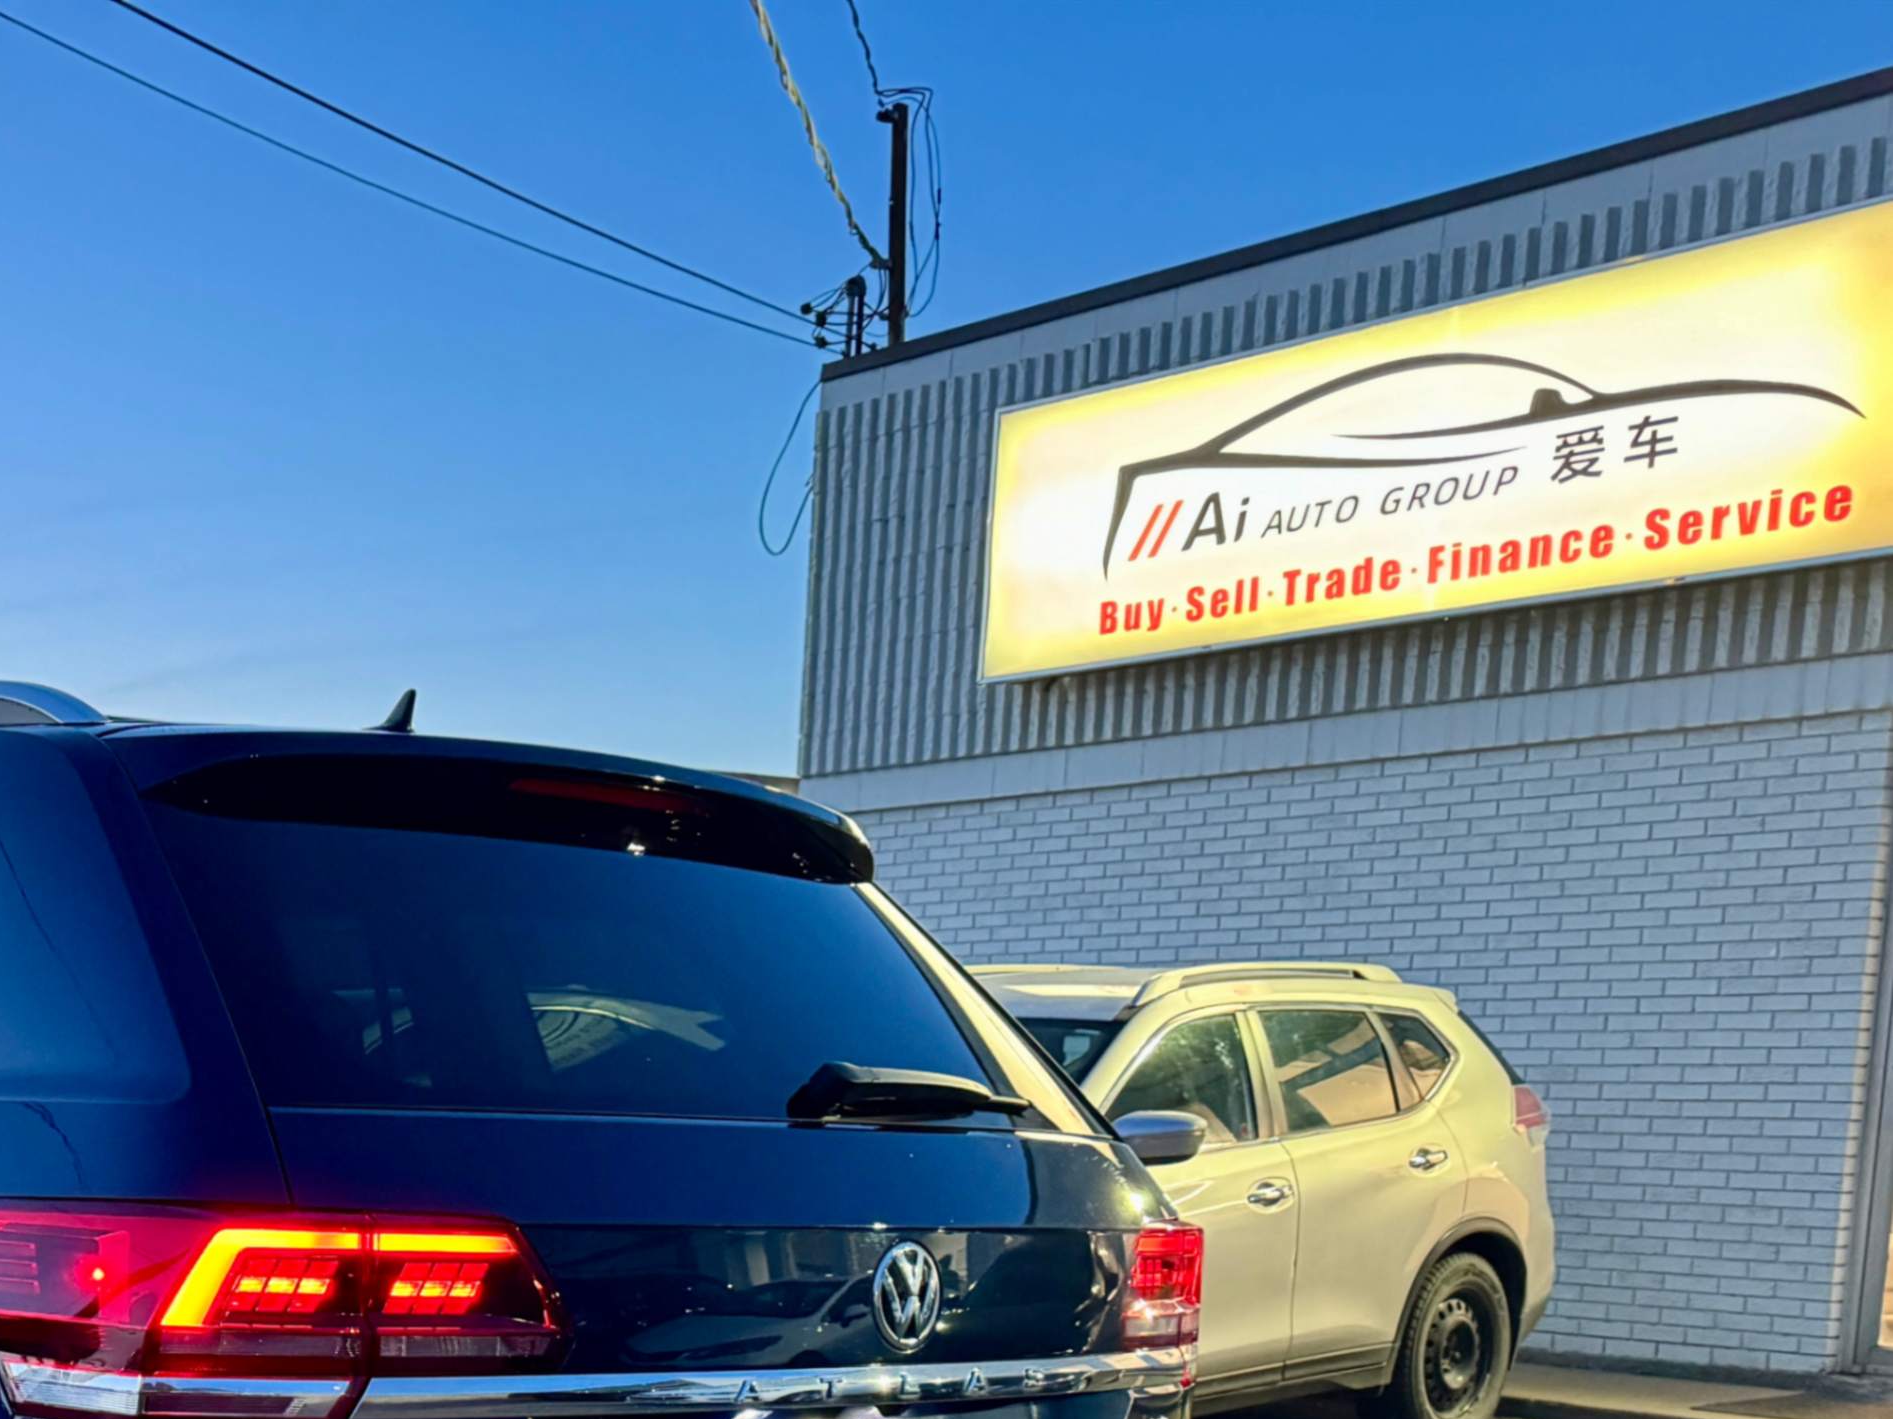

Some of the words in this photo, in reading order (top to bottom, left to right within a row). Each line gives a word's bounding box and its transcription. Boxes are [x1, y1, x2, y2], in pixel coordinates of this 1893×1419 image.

[1550, 415, 1680, 484] 爱车
[1259, 494, 1361, 539] AUTO
[1378, 464, 1520, 516] GROUP
[1099, 598, 1165, 636] Buy
[1185, 575, 1260, 622] Sell
[1282, 557, 1402, 607] Trade
[1426, 523, 1615, 584] Finance
[1643, 484, 1853, 551] Service
[733, 1366, 1047, 1402] ATLAS
